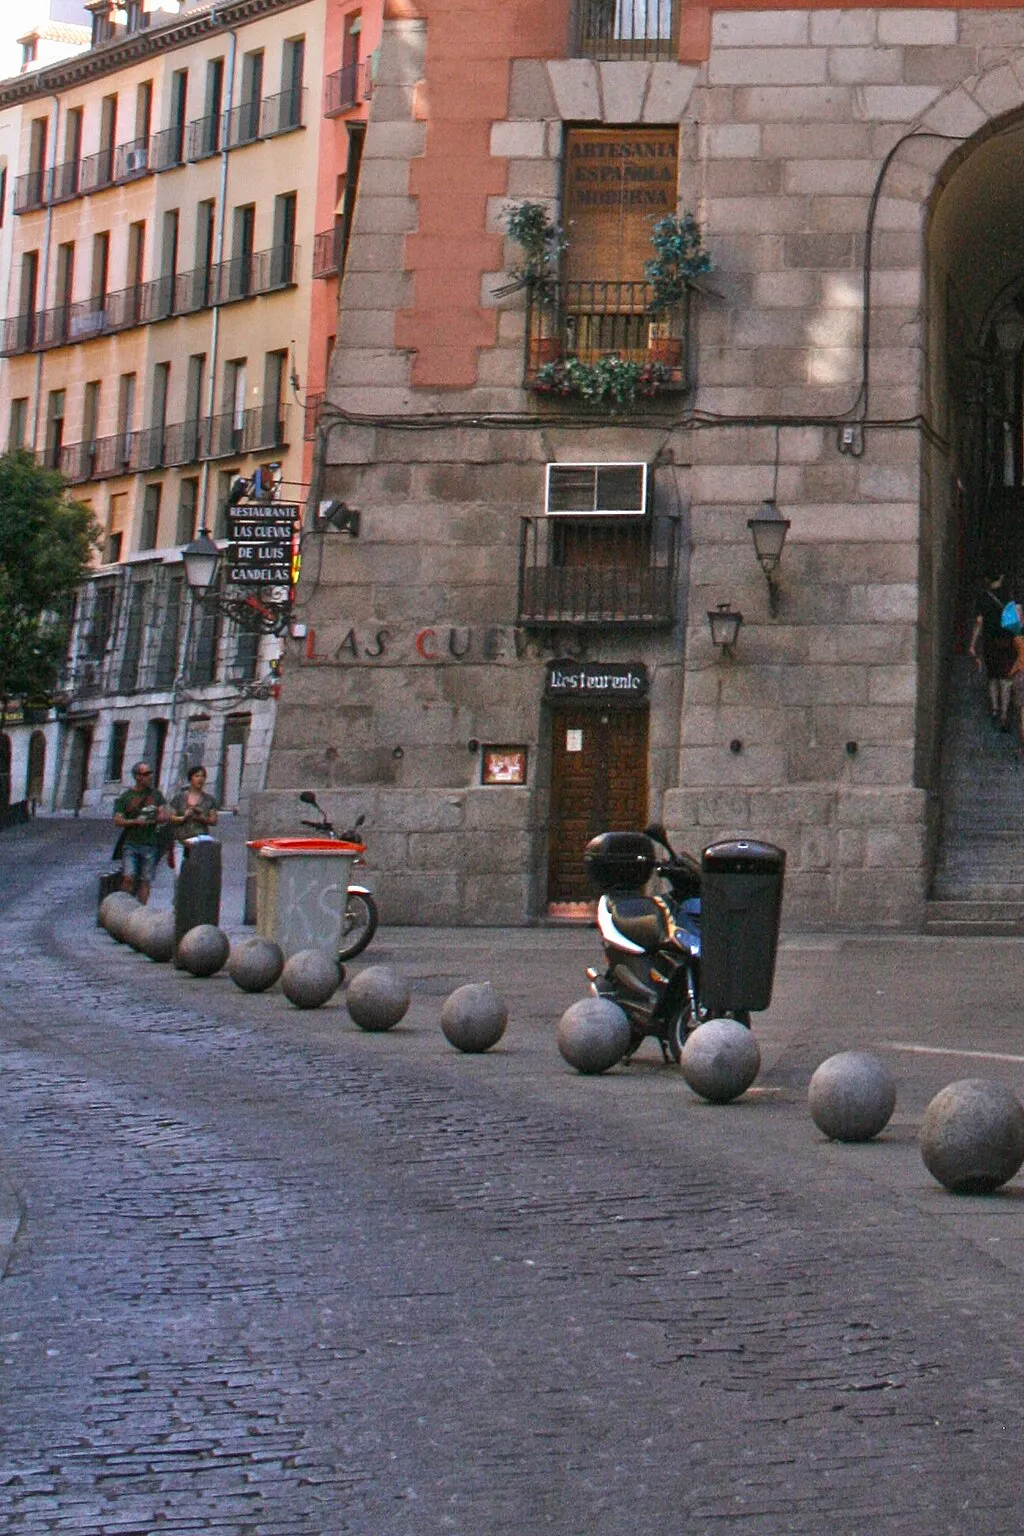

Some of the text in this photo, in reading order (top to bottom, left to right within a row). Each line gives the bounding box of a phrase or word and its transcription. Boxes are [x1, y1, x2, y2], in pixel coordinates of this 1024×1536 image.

[571, 142, 678, 157] ARTESANIA
[230, 507, 297, 517] RESTAURANTE
[234, 526, 291, 537] LAS CUEVAS
[238, 547, 284, 559] DE LUIS
[231, 568, 289, 580] CANDELAS
[305, 628, 390, 660] LAS
[551, 670, 640, 689] Restaurante
